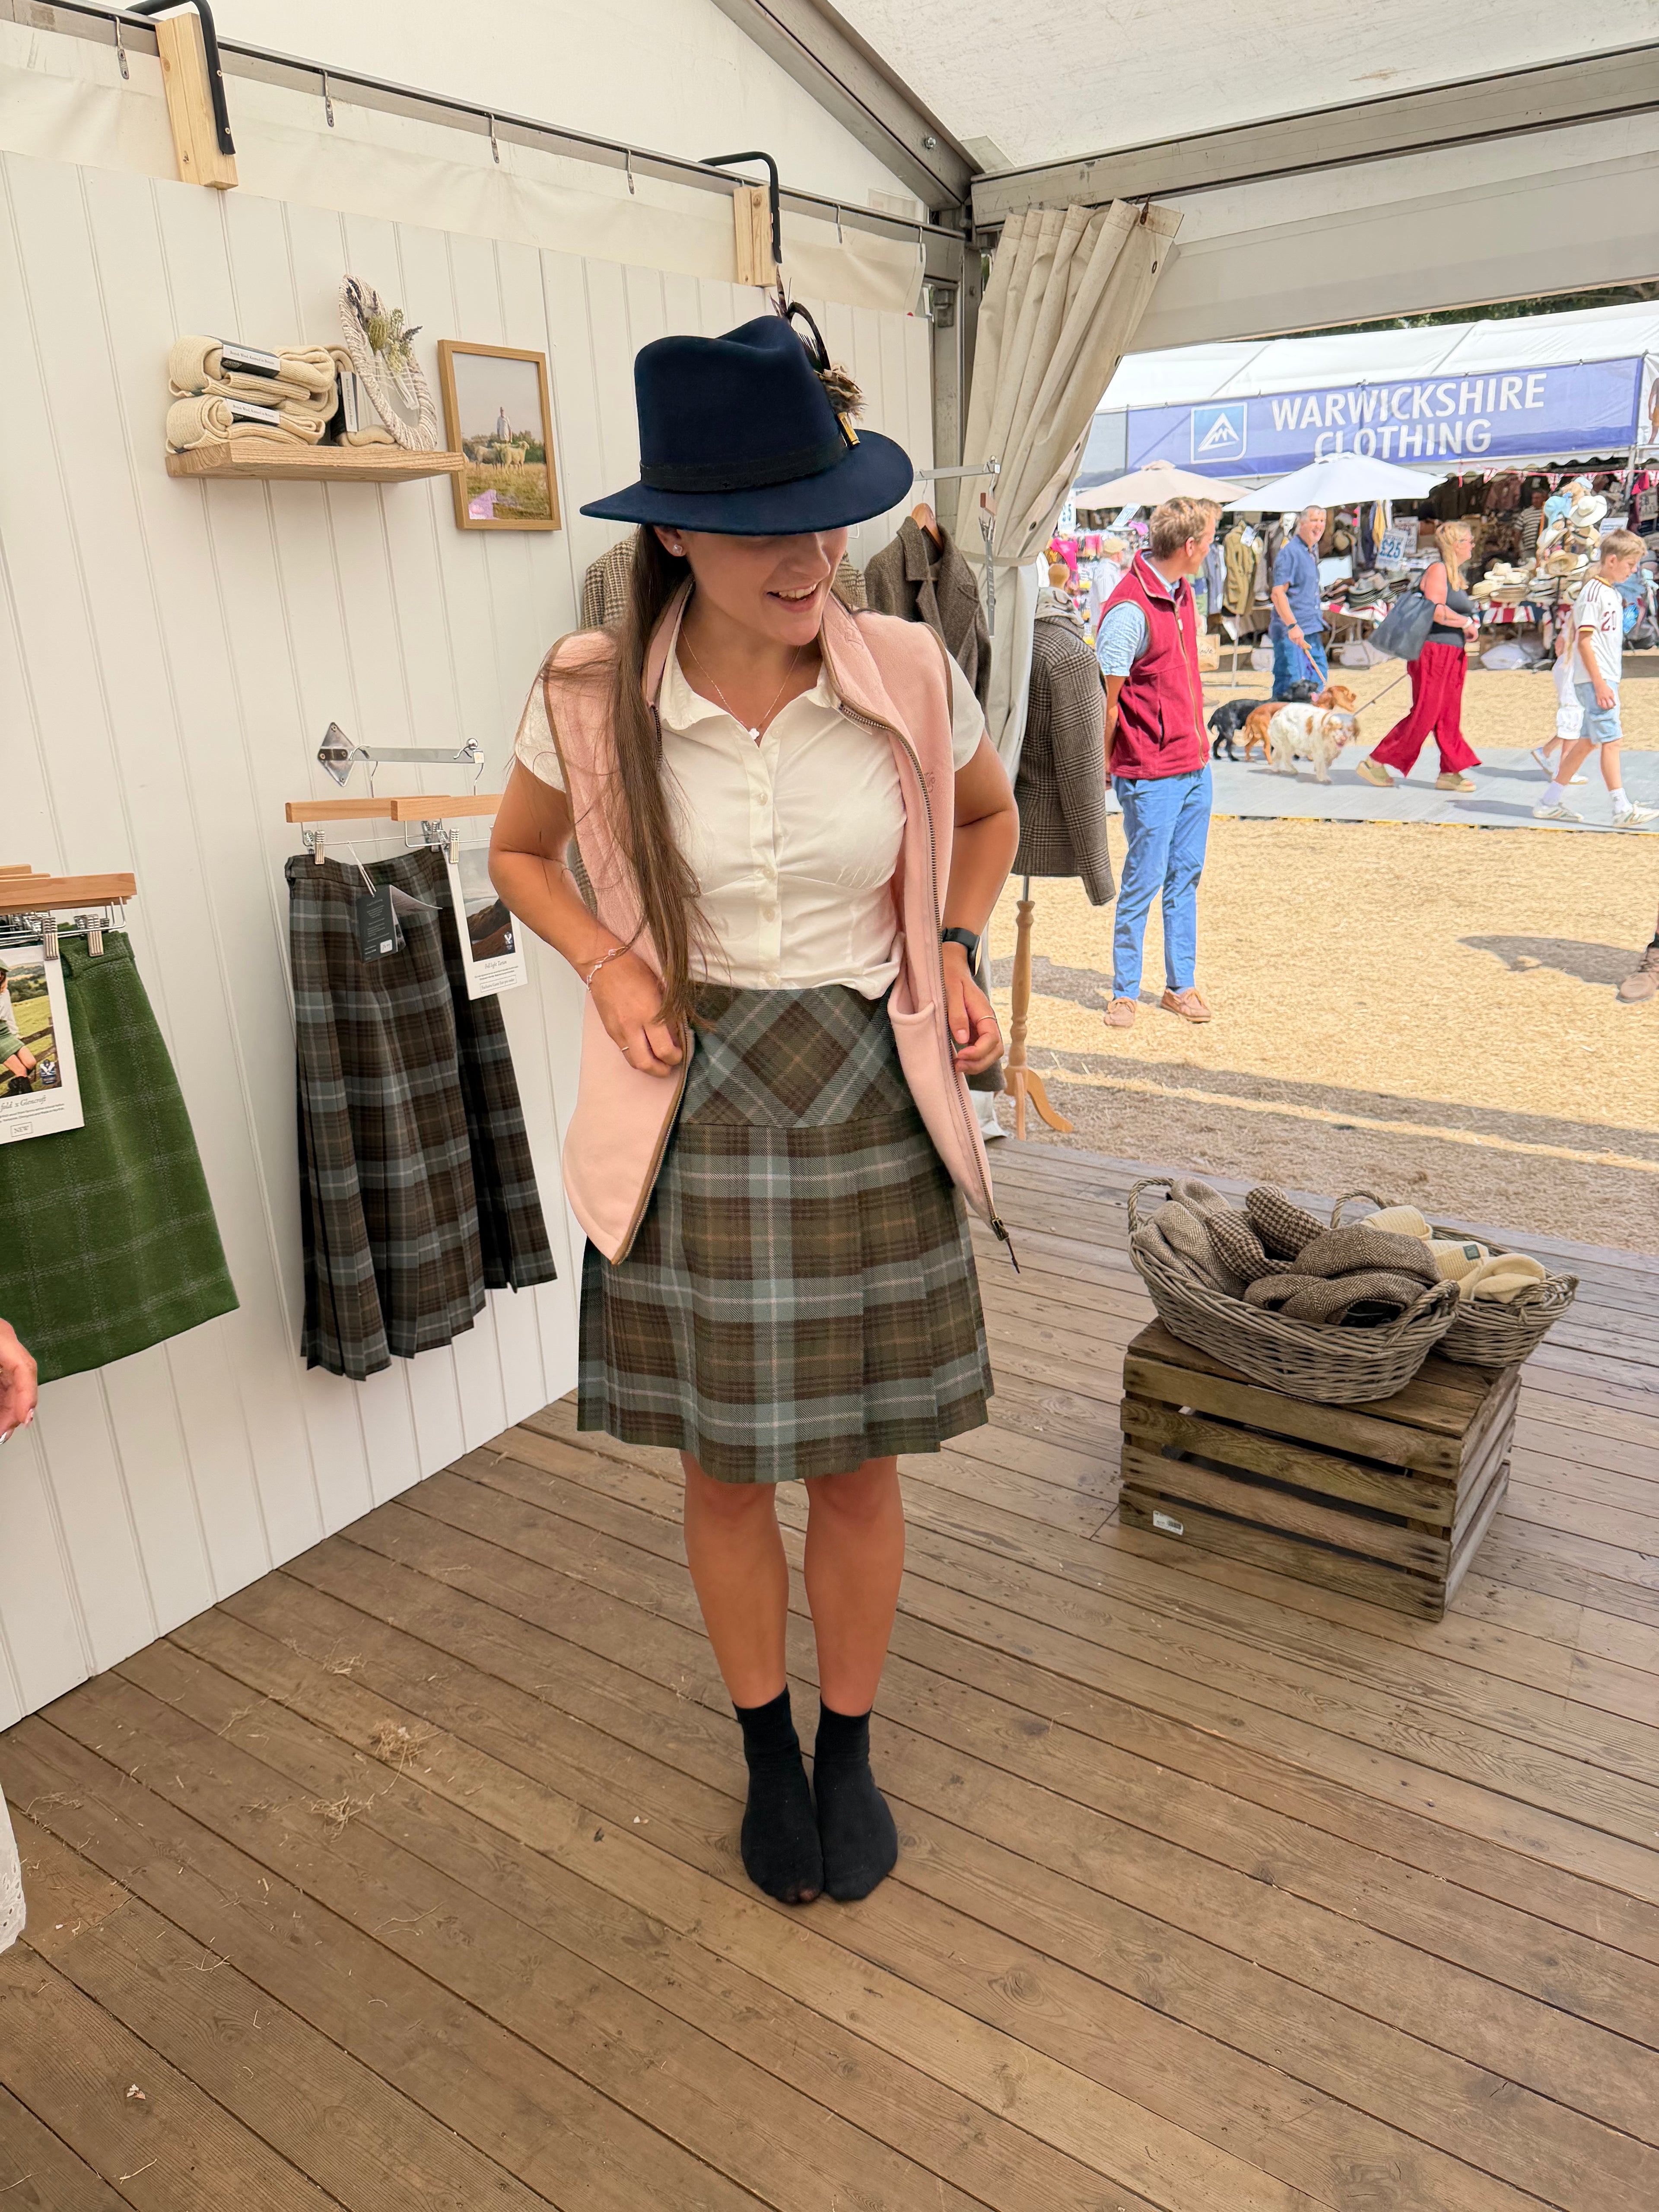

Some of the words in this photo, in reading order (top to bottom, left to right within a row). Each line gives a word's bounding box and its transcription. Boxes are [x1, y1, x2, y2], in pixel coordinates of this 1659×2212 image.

[1271, 373, 1547, 431] WARWICKSHIRE
[1379, 539, 1401, 559] £25
[1601, 610, 1616, 631] 20
[14, 1125, 30, 1134] NEW
